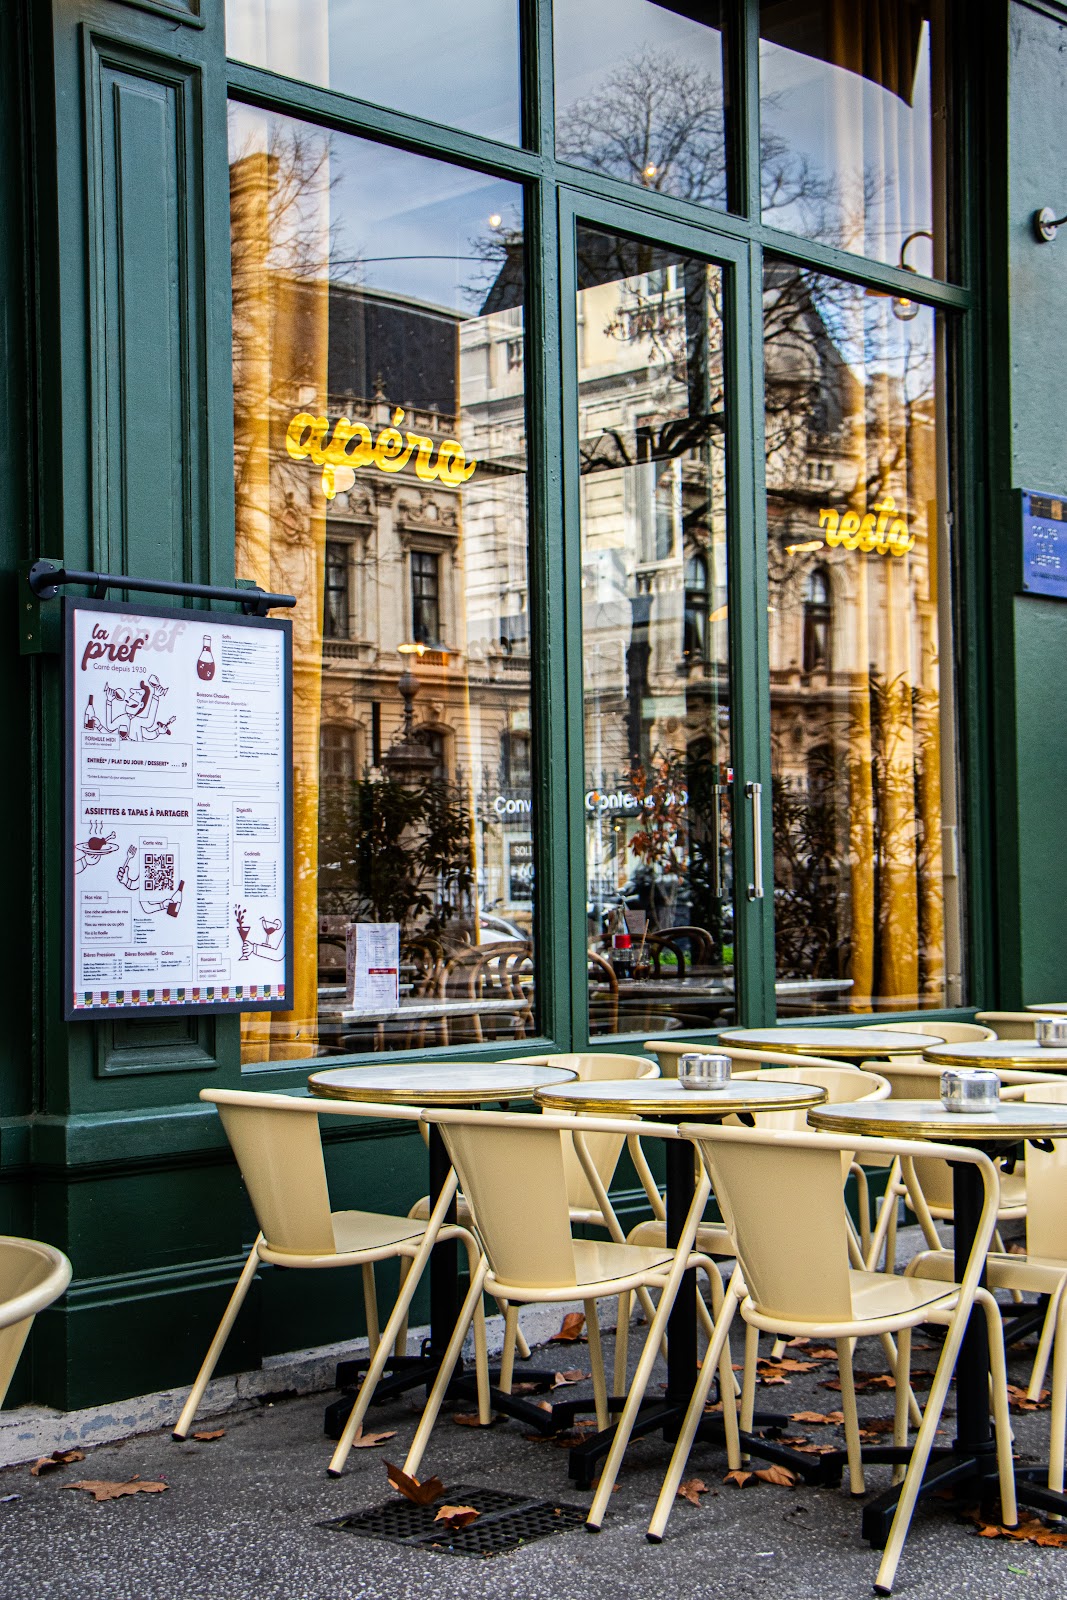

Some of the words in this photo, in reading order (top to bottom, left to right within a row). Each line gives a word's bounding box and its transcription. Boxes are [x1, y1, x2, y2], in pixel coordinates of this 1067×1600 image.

[286, 407, 476, 500] apéro
[818, 496, 915, 557] resto
[92, 623, 109, 640] la
[93, 662, 110, 670] Carré
[111, 664, 130, 673] depuis
[132, 666, 147, 674] 1930
[150, 808, 154, 817] À
